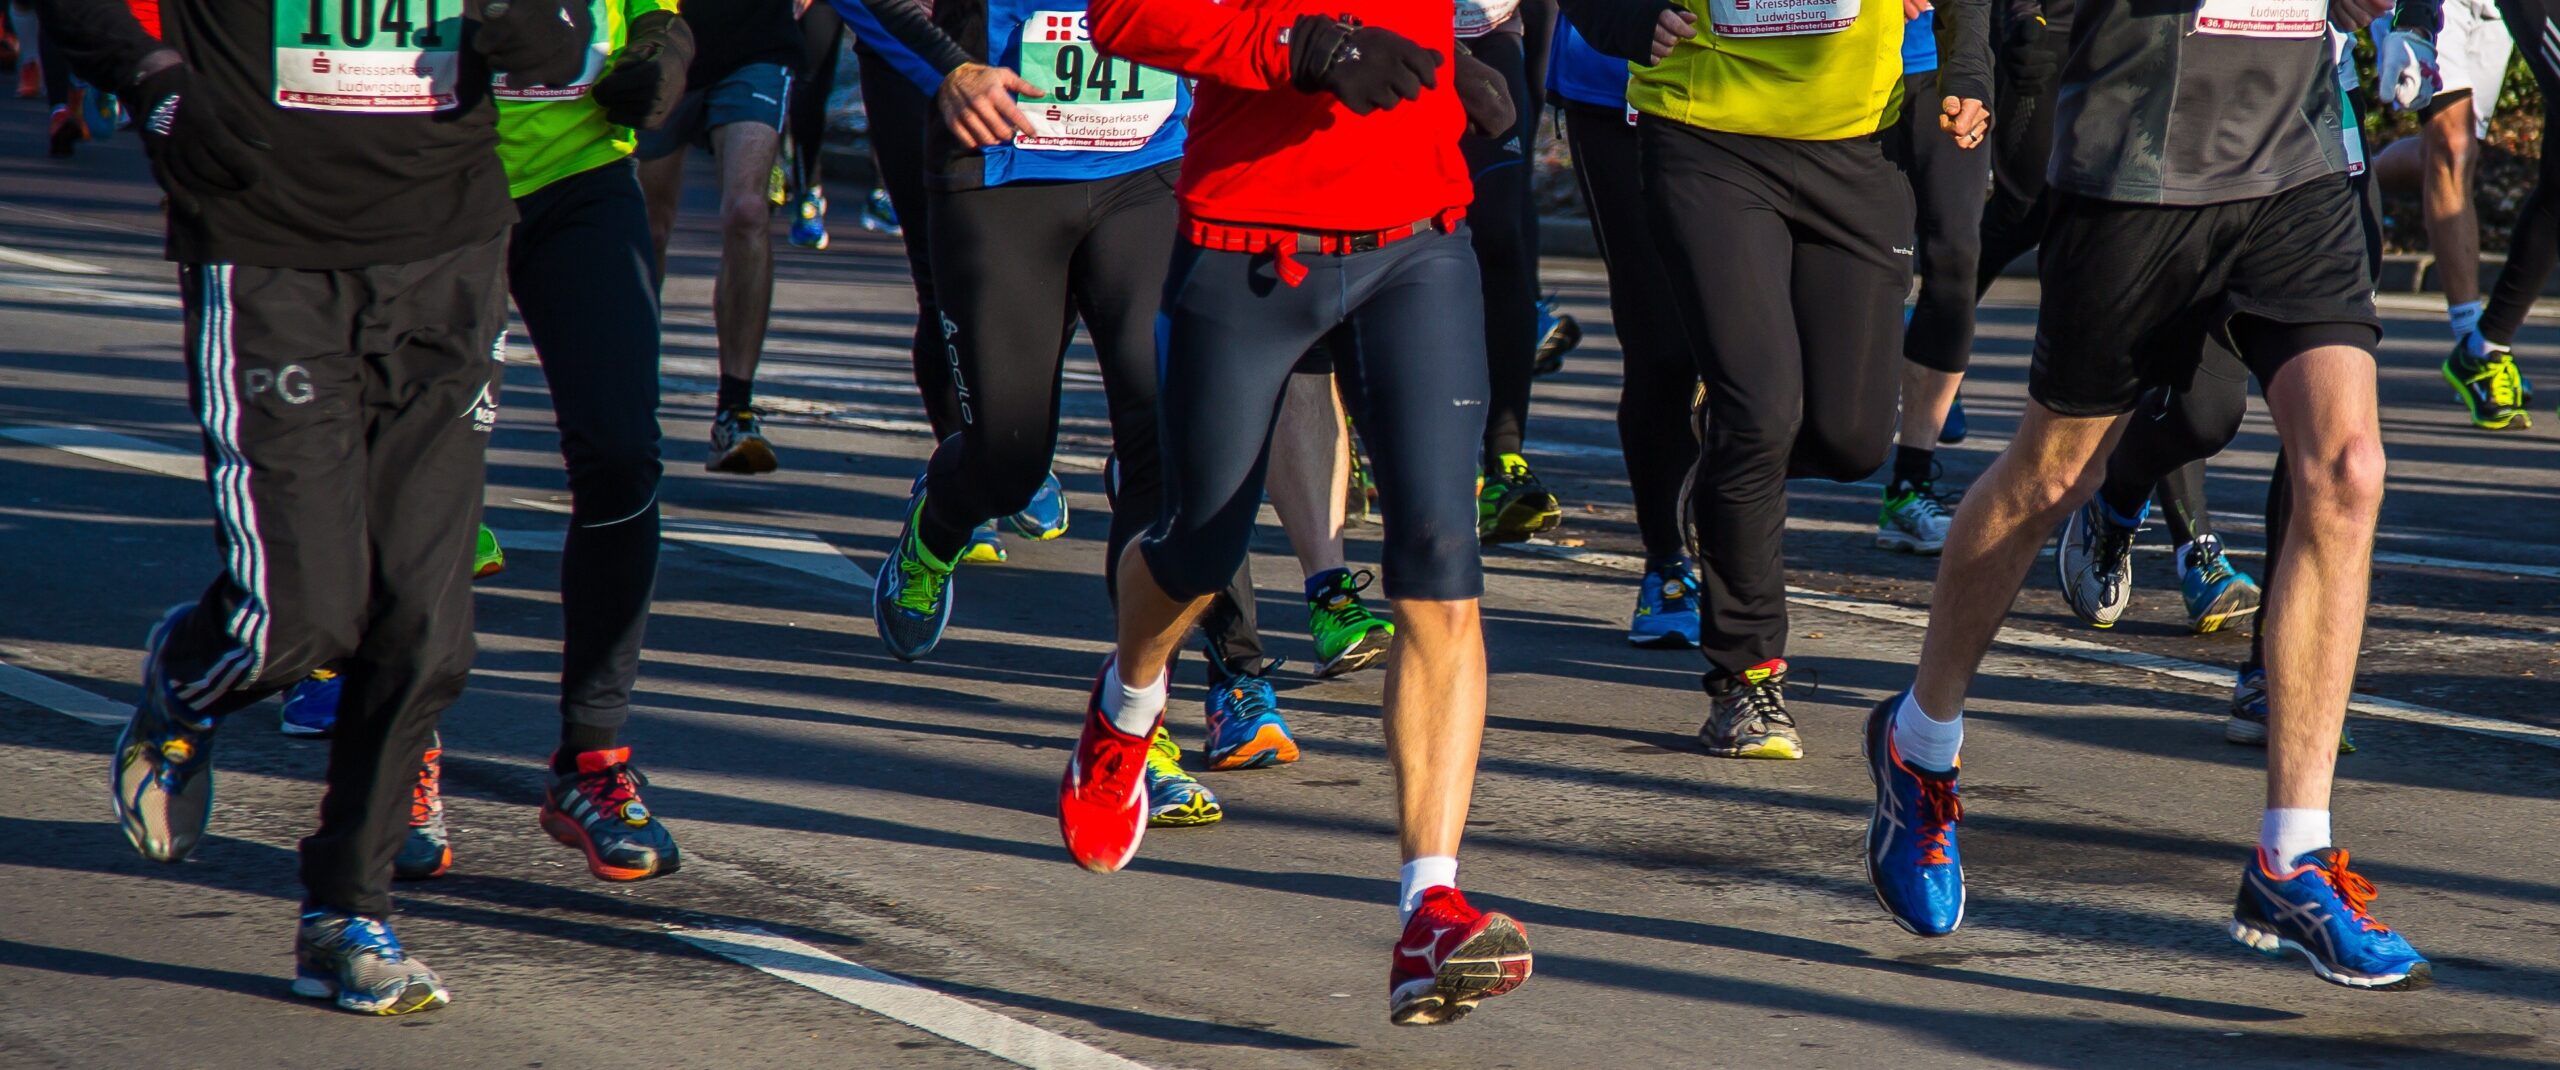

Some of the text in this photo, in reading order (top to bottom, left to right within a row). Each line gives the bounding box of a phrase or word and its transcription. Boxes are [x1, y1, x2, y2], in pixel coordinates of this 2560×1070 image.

[1755, 0, 1837, 9] Kreissparkasse
[1756, 10, 1826, 23] Ludwigsburg
[2250, 6, 2309, 20] Ludwigsburg
[301, 0, 442, 48] 1041
[1733, 24, 1784, 34] Bietigheimer
[1786, 22, 1835, 31] Silvesterlauf
[2207, 18, 2220, 28] 36.
[2223, 20, 2274, 31] Bietigheimer
[338, 63, 433, 76] Kreissparkasse
[1055, 45, 1144, 101] 941
[337, 79, 421, 95] Ludwigsburg
[1066, 112, 1149, 125] Kreissparkasse
[1065, 125, 1137, 138] Ludwigsburg
[1039, 137, 1092, 146] Bietigheimer
[1094, 137, 1144, 146] Silvesterlauf
[245, 364, 315, 404] PG
